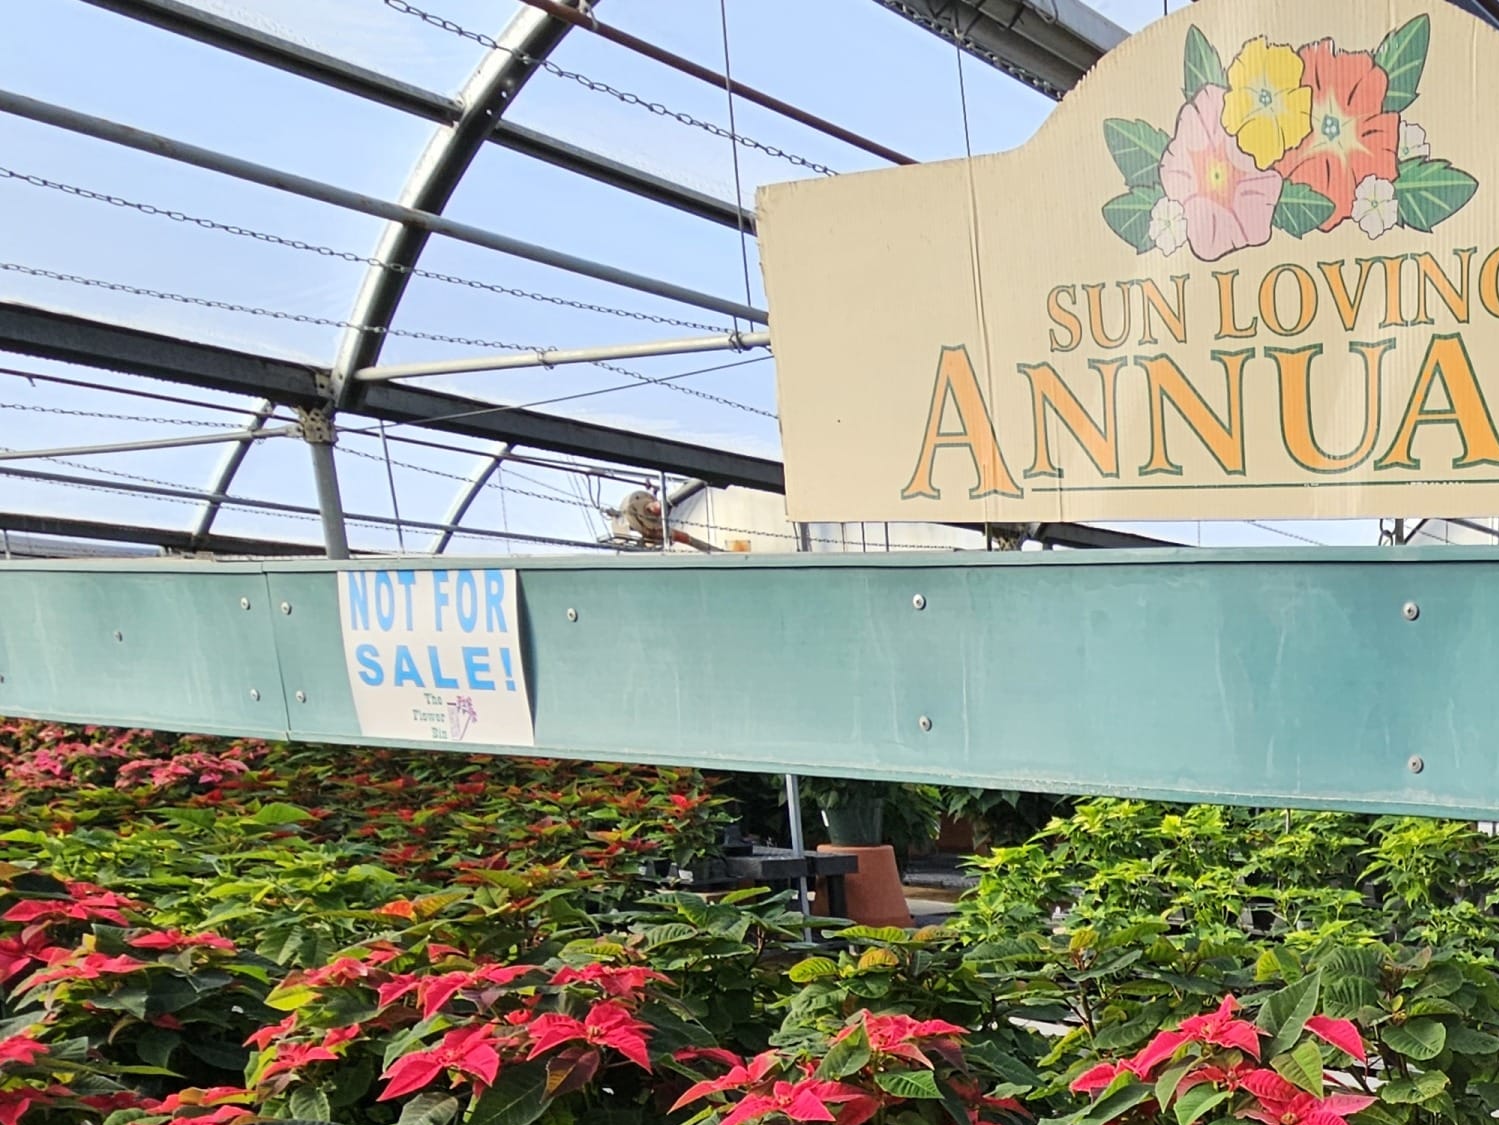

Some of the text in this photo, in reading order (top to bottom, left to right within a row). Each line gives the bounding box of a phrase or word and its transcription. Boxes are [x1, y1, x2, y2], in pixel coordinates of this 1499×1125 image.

[1045, 273, 1191, 353] SUN
[347, 569, 508, 633] NOT FOR
[355, 643, 516, 691] SALE!
[423, 692, 443, 705] The
